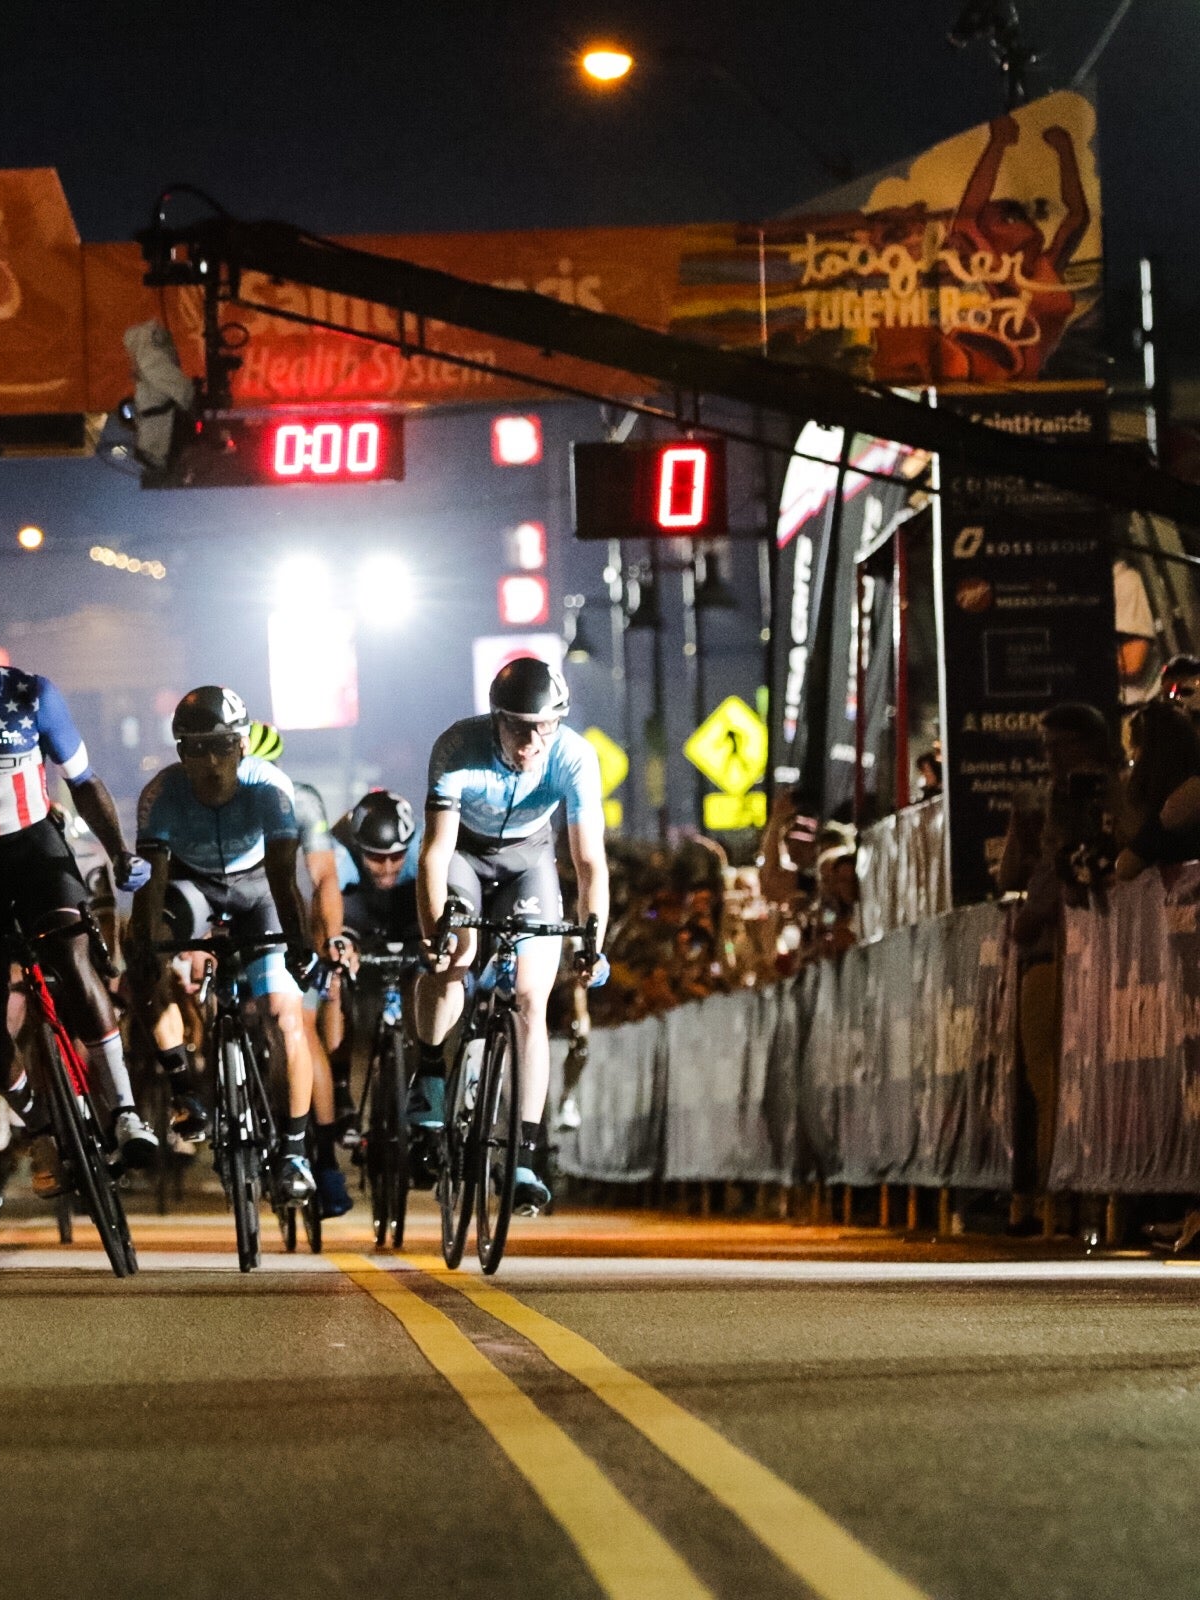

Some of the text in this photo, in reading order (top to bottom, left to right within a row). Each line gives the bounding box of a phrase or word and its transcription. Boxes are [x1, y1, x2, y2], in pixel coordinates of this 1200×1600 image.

[242, 343, 496, 393] Health System
[273, 421, 380, 476] 0:00
[655, 447, 708, 528] 0
